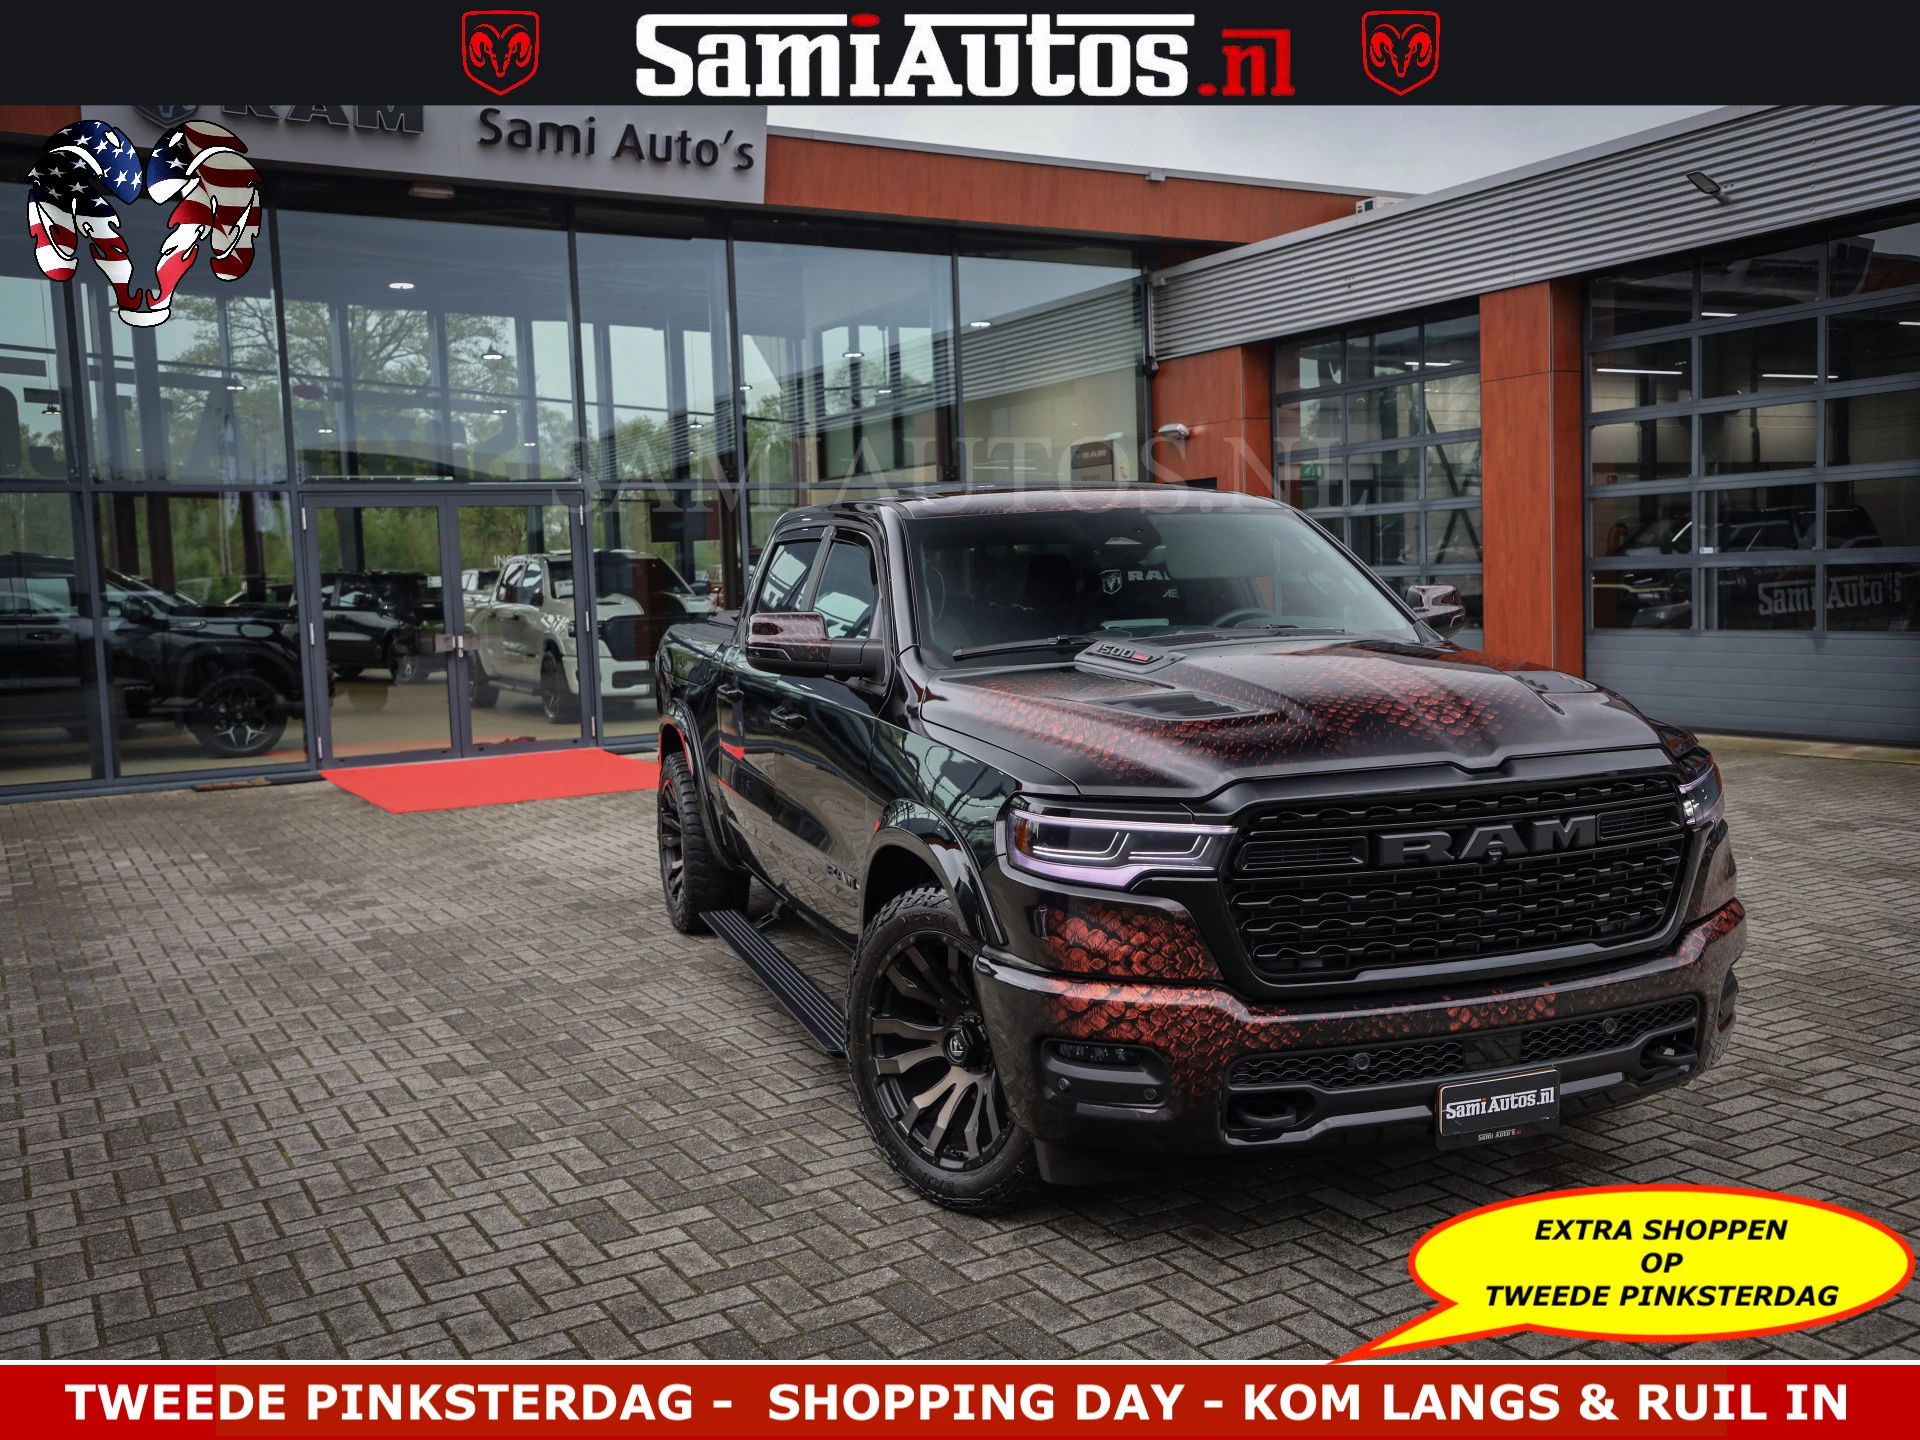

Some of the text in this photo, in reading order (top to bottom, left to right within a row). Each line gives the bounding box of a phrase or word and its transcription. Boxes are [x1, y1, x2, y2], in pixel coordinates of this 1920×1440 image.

[477, 107, 755, 173] Sami Auto's
[1379, 815, 1597, 866] RAM
